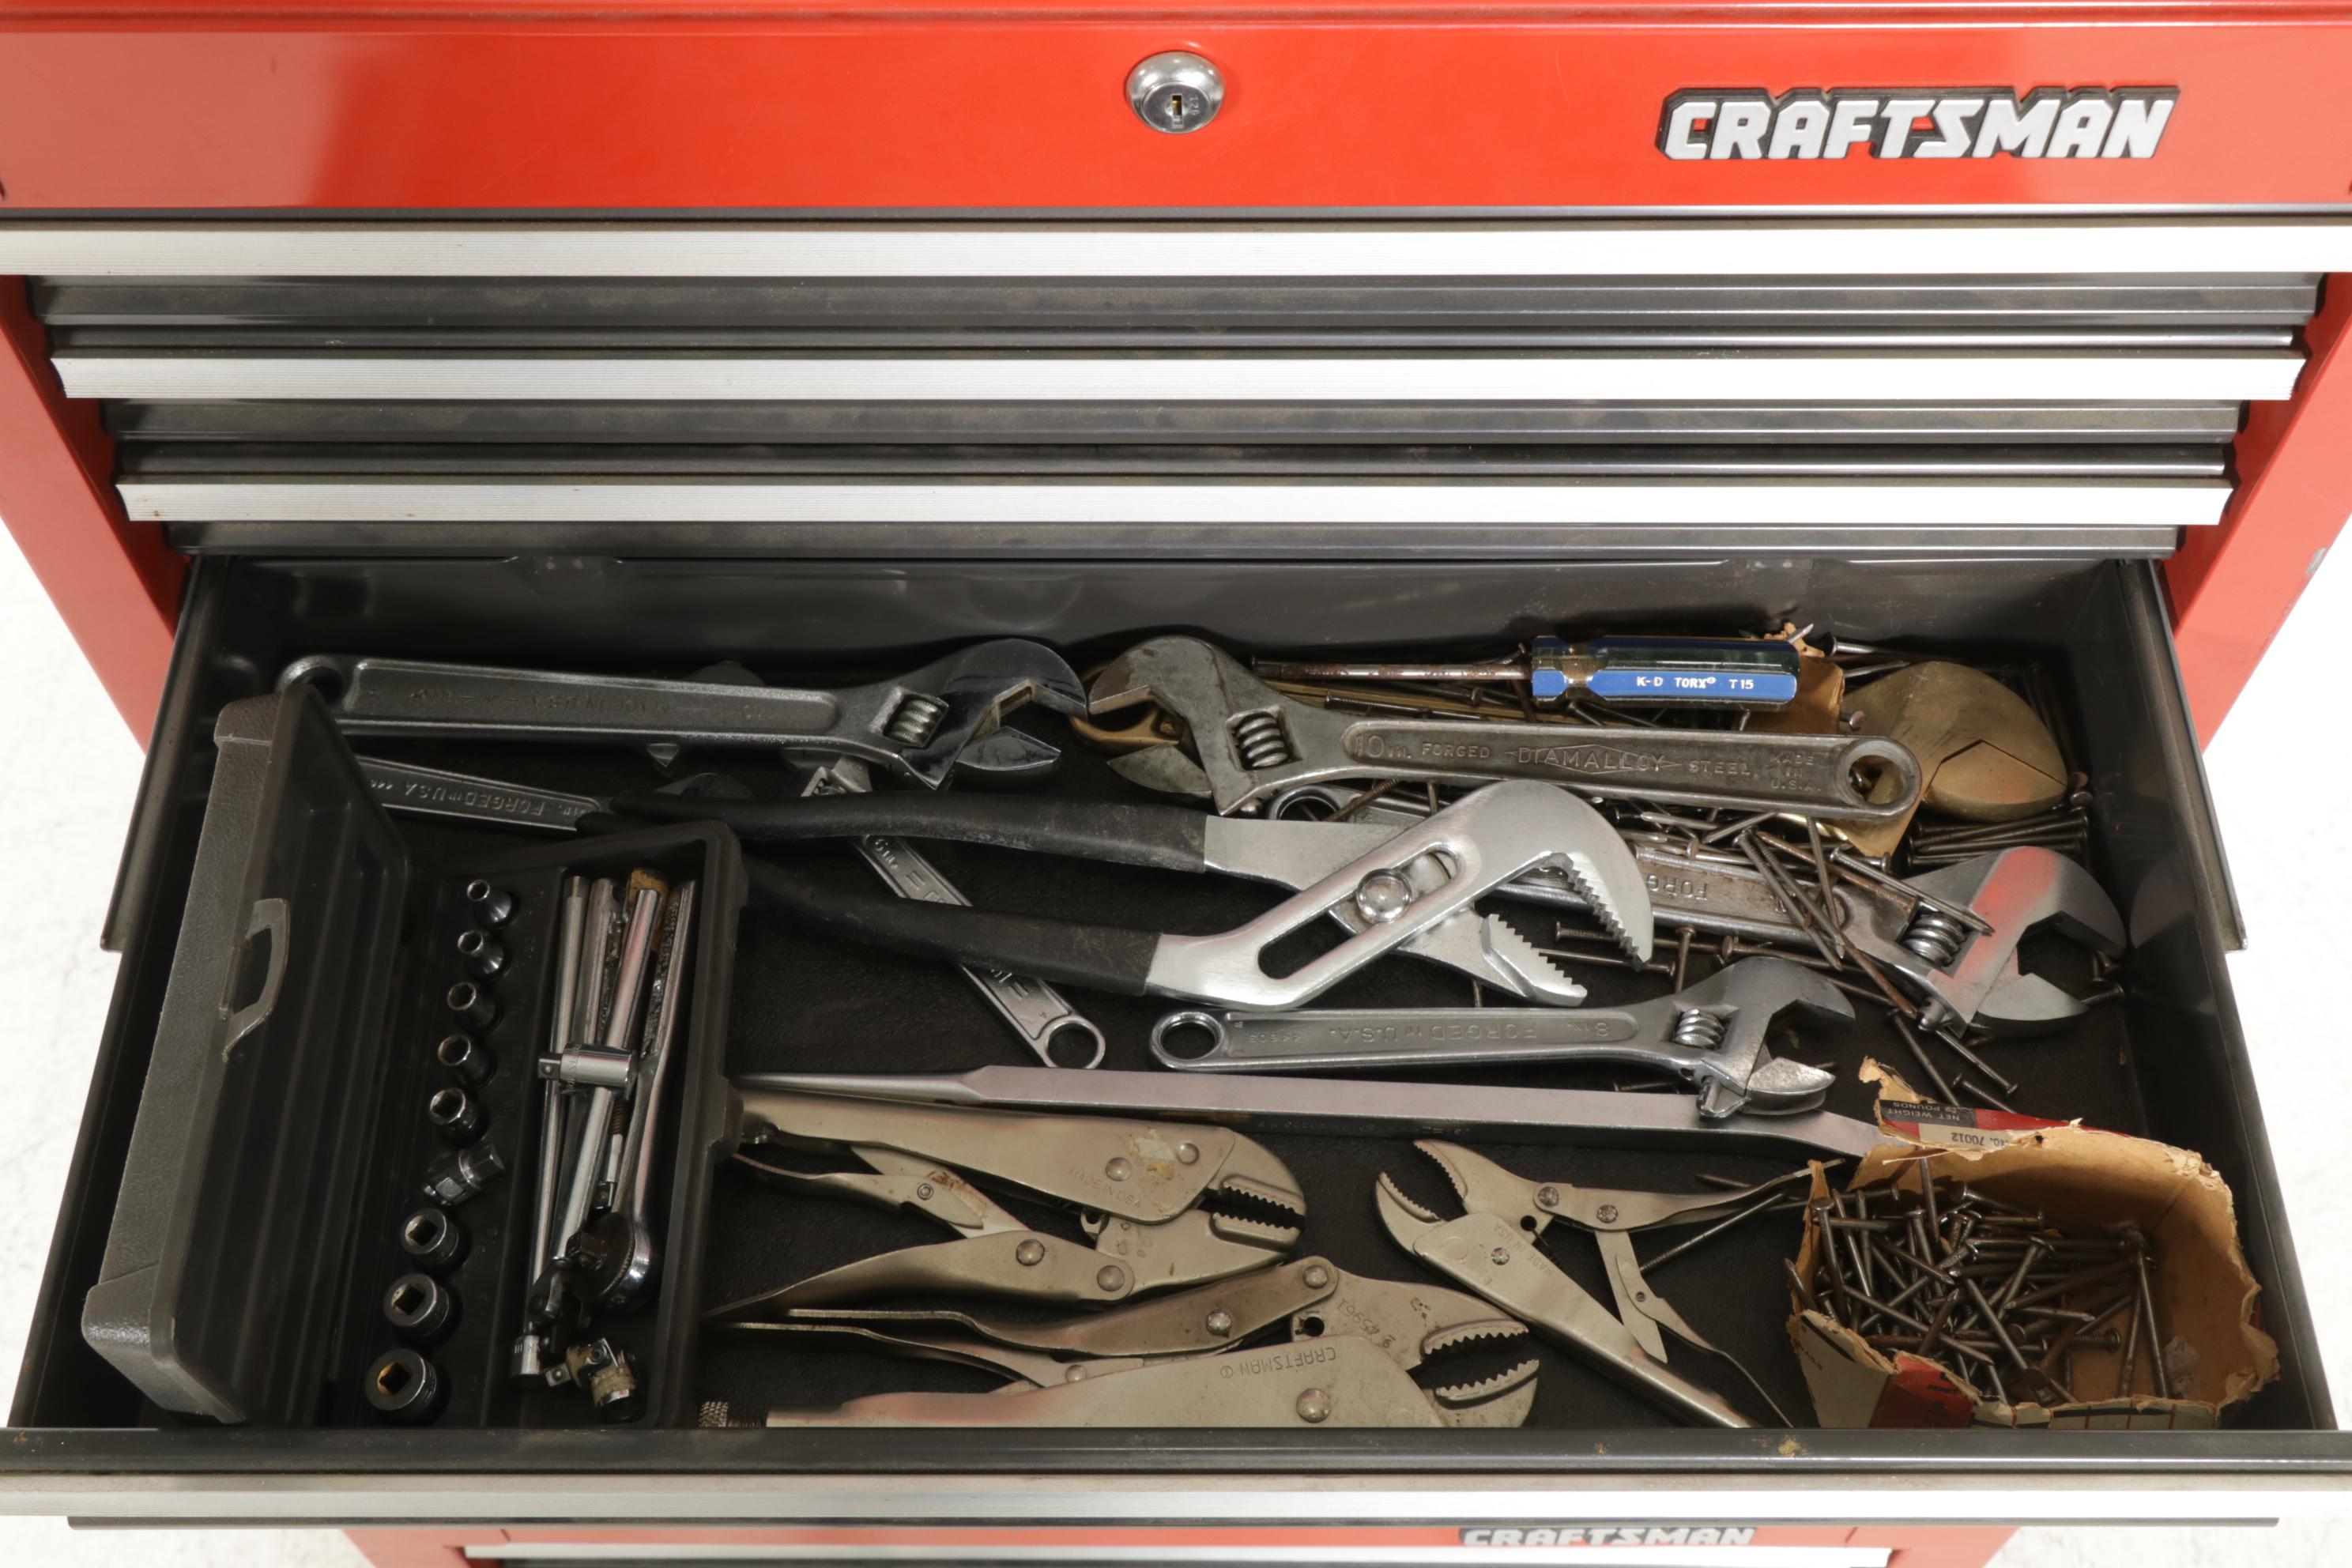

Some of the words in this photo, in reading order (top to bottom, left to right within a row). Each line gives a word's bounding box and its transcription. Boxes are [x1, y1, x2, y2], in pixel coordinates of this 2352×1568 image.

[1662, 96, 2175, 160] CRAFTSMAN
[1421, 741, 1491, 760] FORGED
[1516, 745, 1665, 773] DIAMALLOY
[465, 790, 545, 817] FORGED
[1645, 873, 1709, 902] FORG
[1430, 1023, 1538, 1042] FORGED
[1593, 1021, 1611, 1039] 8
[1886, 1106, 1933, 1119] WEIGHT
[1936, 1113, 1961, 1121] NET
[1951, 1132, 1985, 1147] 70012
[1238, 1345, 1337, 1375] CRAFTSMAN
[1463, 1527, 1757, 1547] CRAFTSMAN
